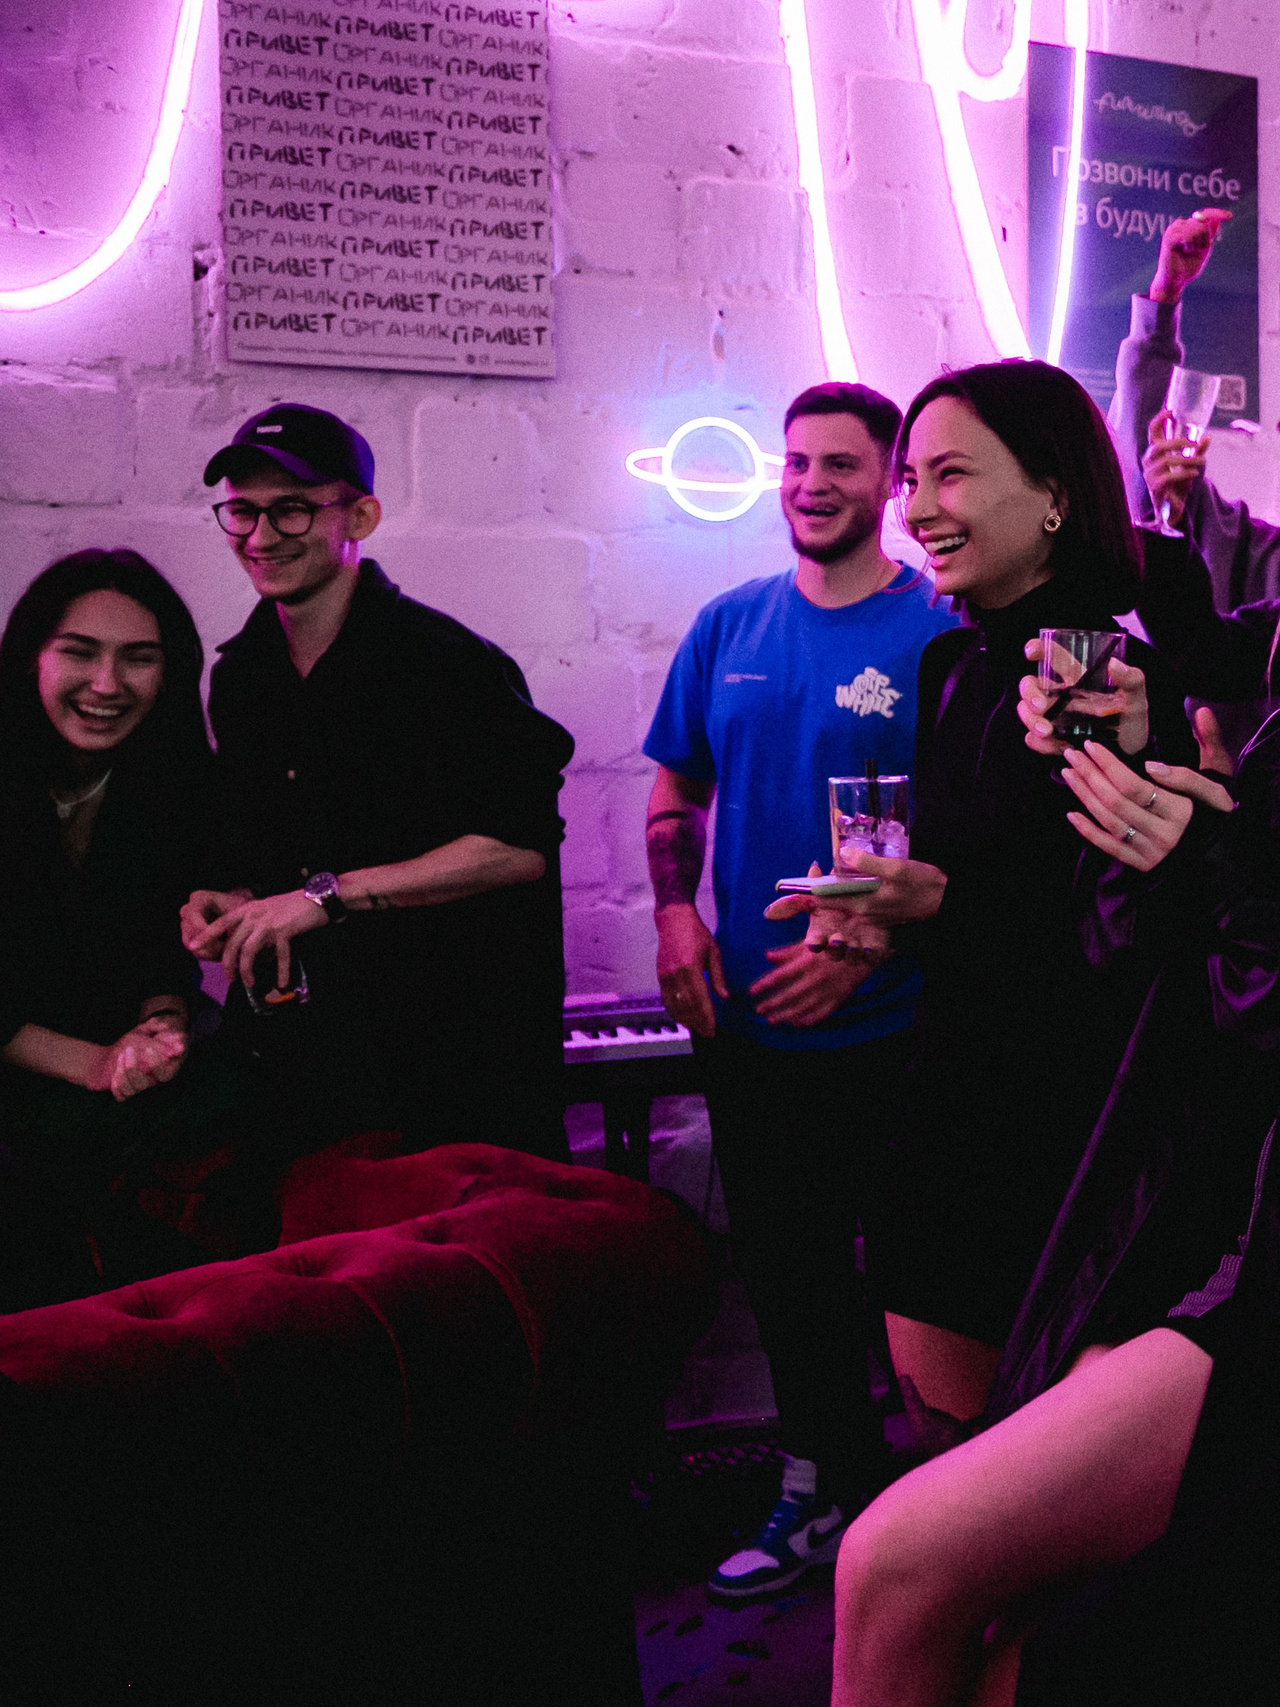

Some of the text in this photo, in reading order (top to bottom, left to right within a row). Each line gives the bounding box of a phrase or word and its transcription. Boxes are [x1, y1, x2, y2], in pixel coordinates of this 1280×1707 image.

[445, 4, 540, 28] ПРИВЕТ
[335, 16, 434, 43] ПРИВЕТ
[439, 29, 543, 56] ОРГАНИК
[224, 29, 541, 82] ПРИВЕТ ОРГАНИК ПРИВЕТ
[338, 72, 435, 97] ПРИВЕТ
[440, 82, 544, 108] ОРГАНИК
[227, 86, 541, 134] ПРИВЕТ ОРГАНИК ПРИВЕТ
[339, 127, 436, 150] ПРИВЕТ
[442, 136, 545, 161] ОРГАНИК
[229, 142, 542, 188] ПРИВЕТ ОРГАНИК ПРИВЕТ
[340, 181, 438, 205] ПРИВЕТ
[443, 191, 546, 214] ОРГАНИК
[1178, 168, 1241, 200] себе
[230, 199, 544, 241] ПРИВЕТ ОРГАНИК ПРИВЕТ
[342, 237, 439, 259] ПРИВЕТ
[444, 244, 548, 266] ОРГАНИК
[232, 256, 546, 293] ПРИВЕТ ОРГАНИК ПРИВЕТ
[343, 292, 441, 313] ПРИВЕТ
[446, 298, 548, 319] ОРГАНИК
[233, 312, 547, 346] ПРИВЕТ ОРГАНИК ПРИВЕТ
[835, 684, 901, 718] WHITE
